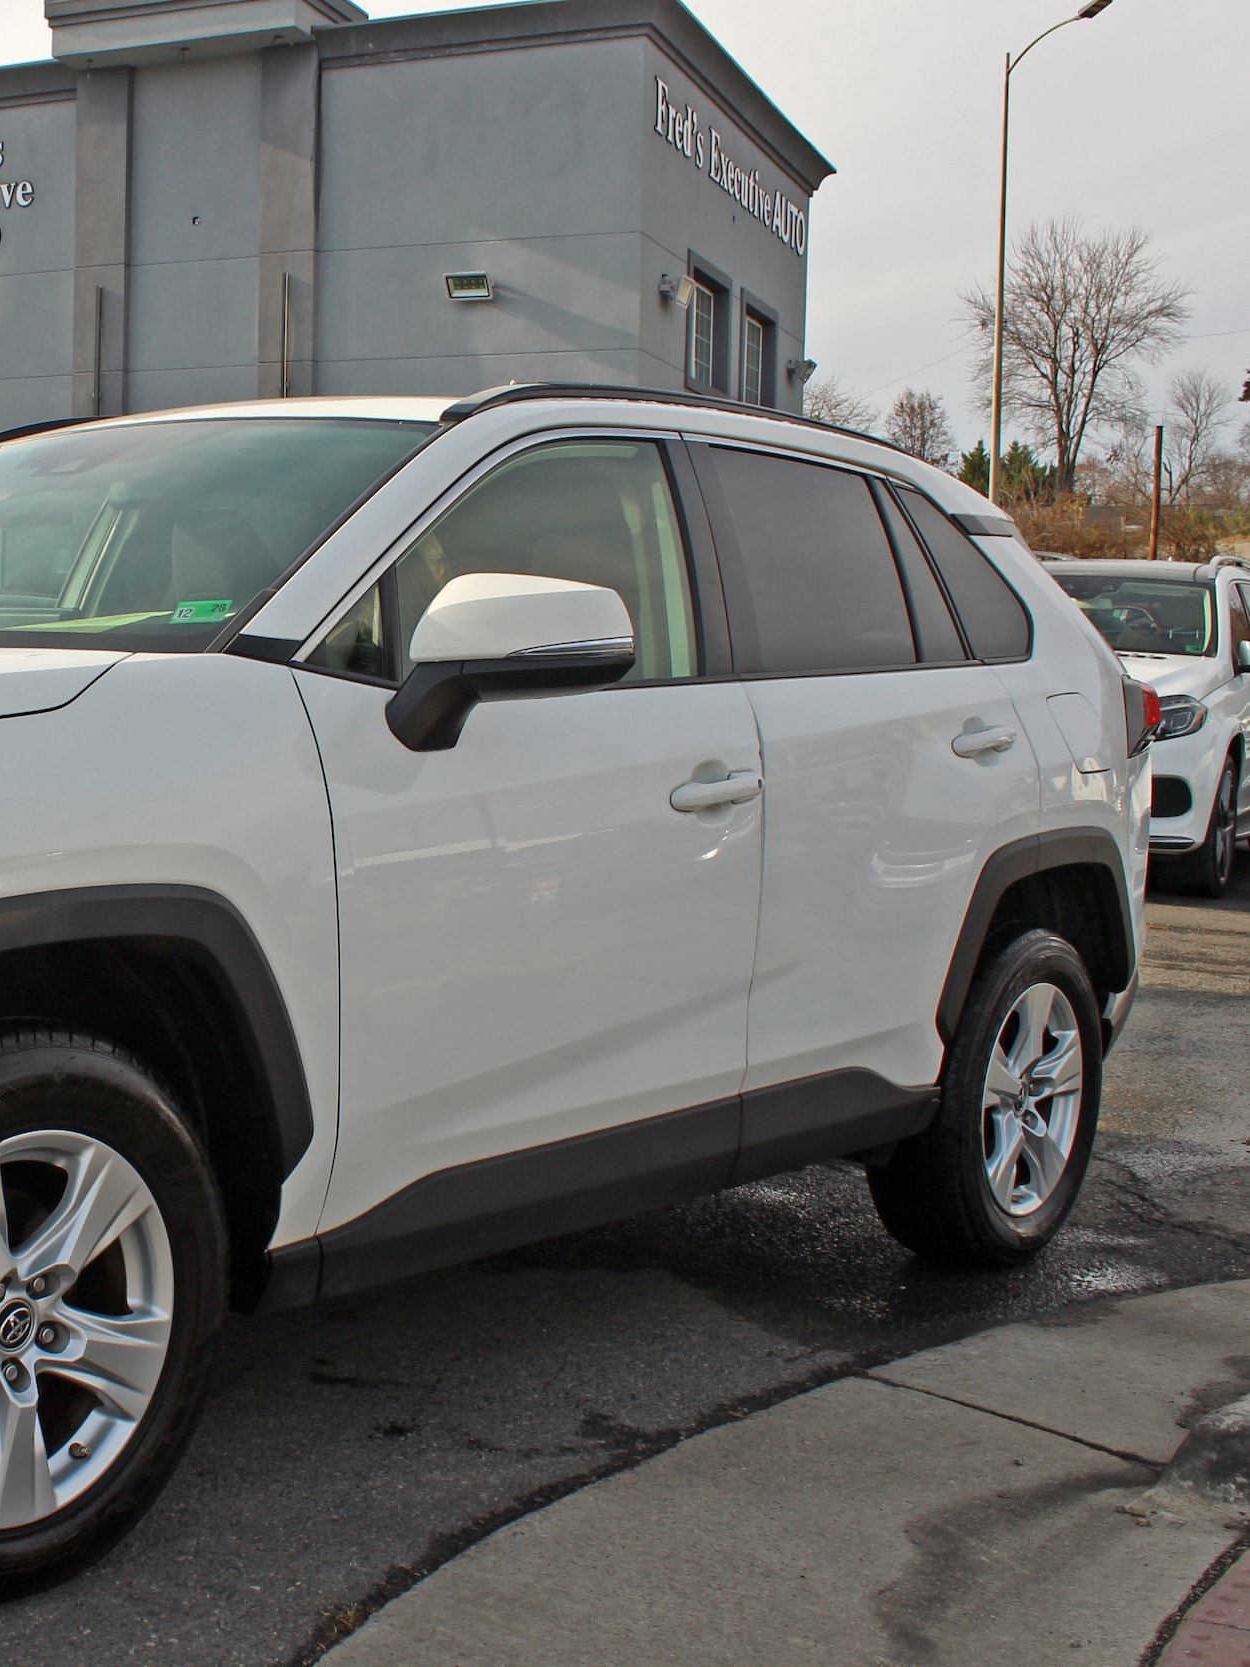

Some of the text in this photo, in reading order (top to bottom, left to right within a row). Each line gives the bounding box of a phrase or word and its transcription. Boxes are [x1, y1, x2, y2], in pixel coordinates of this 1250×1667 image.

[654, 76, 806, 256] Fred's Executive AUTO
[176, 608, 193, 619] 12
